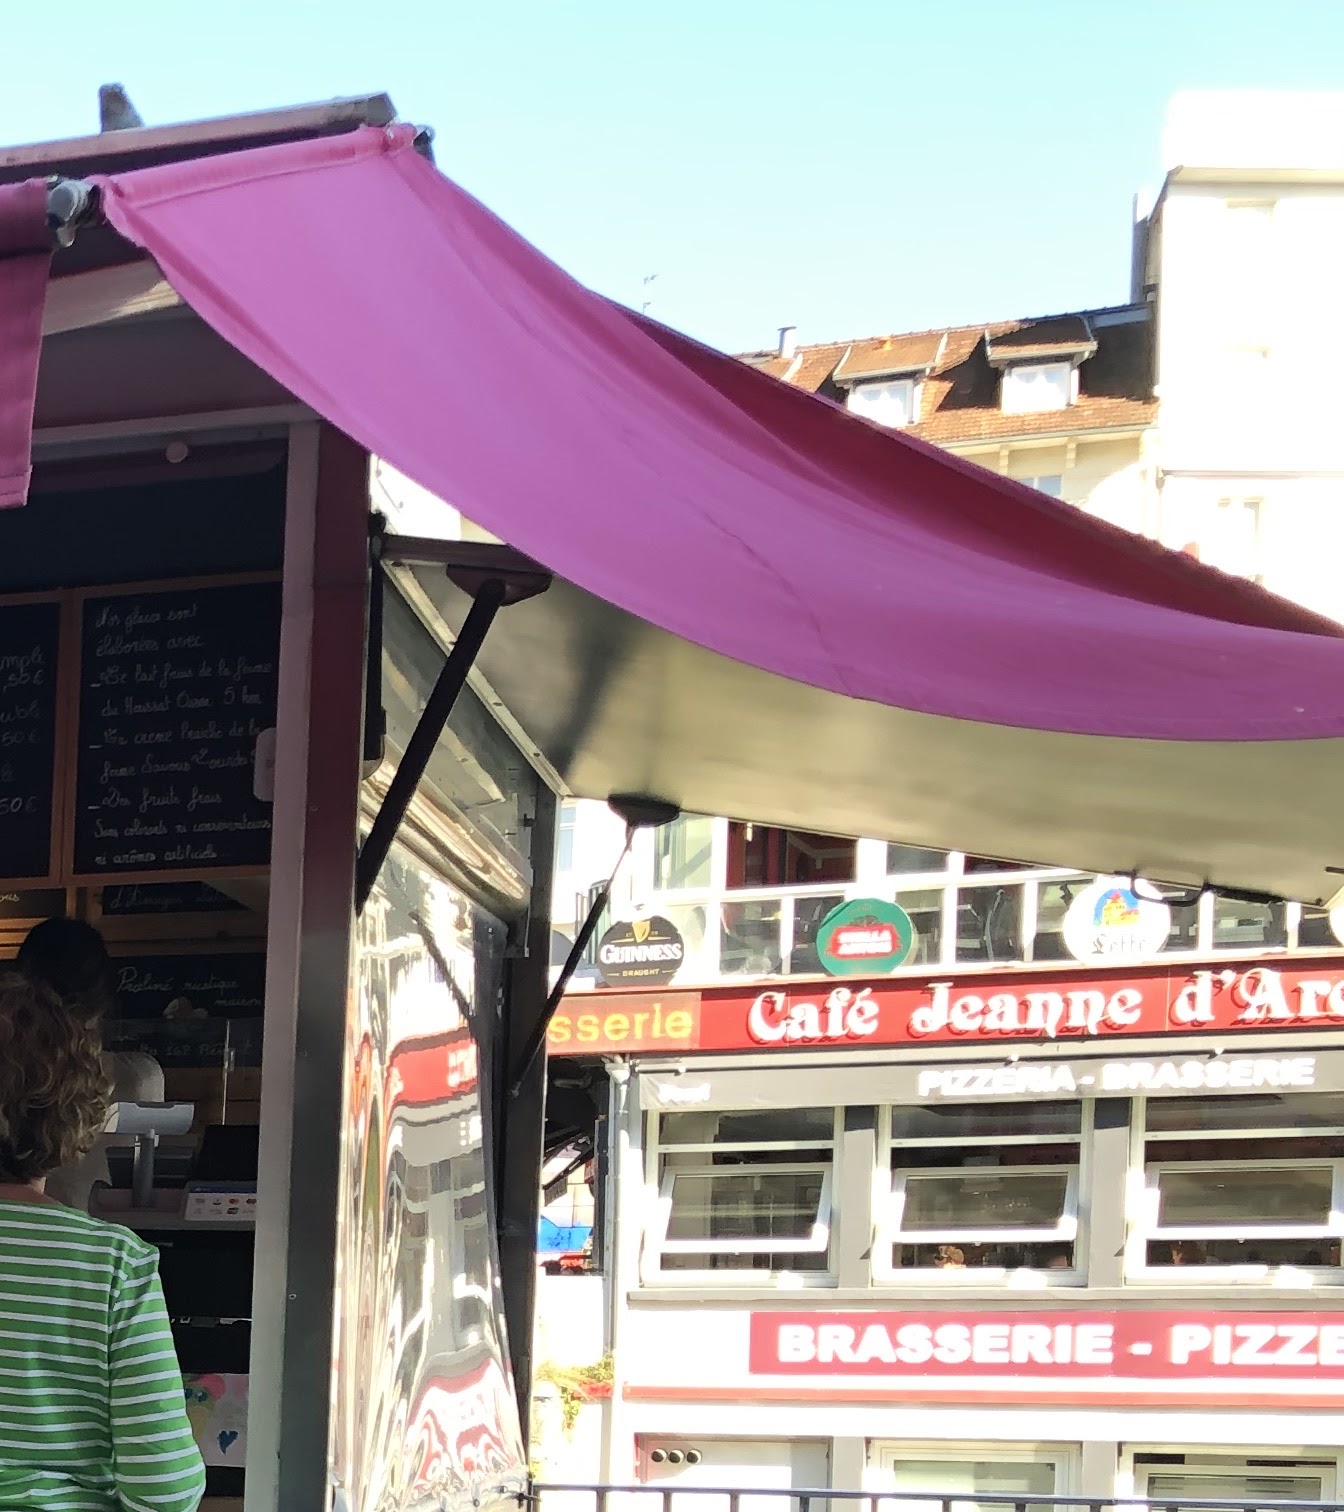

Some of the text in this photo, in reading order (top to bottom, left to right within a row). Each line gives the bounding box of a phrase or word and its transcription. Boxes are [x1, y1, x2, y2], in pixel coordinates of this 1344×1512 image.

[167, 636, 205, 650] avec
[224, 686, 235, 705] 5
[600, 943, 683, 965] GUINNESS
[622, 968, 661, 977] DRAUGHT
[748, 989, 879, 1042] Café
[912, 981, 1144, 1039] Jeanne
[918, 1063, 1076, 1096] PIZZERIA
[1102, 1058, 1316, 1090] BRASSERIE
[777, 1324, 1113, 1364] BRASSERIE
